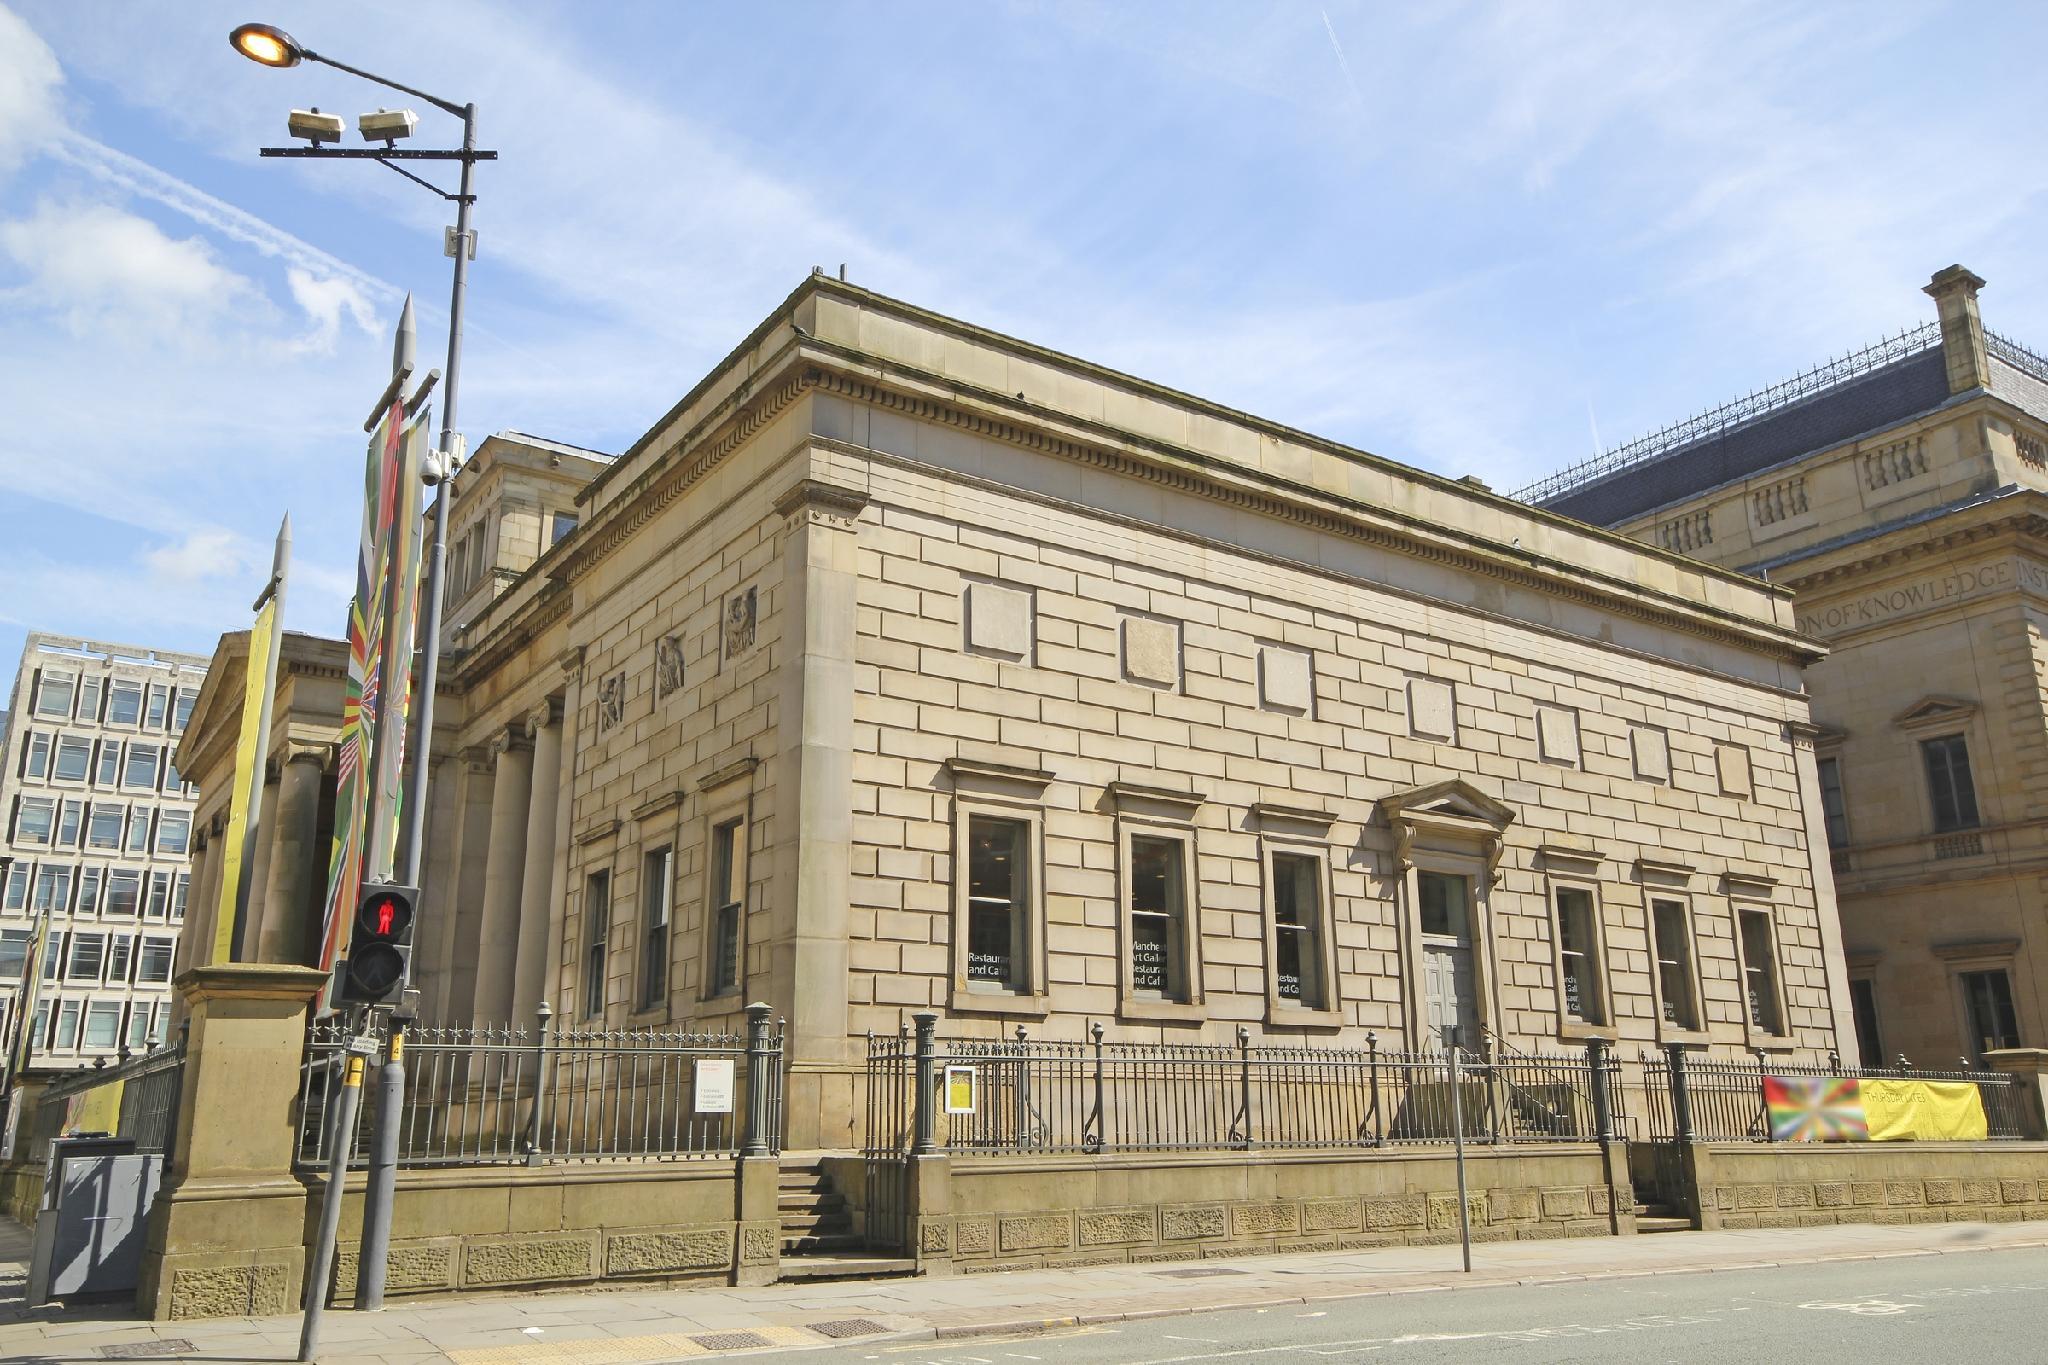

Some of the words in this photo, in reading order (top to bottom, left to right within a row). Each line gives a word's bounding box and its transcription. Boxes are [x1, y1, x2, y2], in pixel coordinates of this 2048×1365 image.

[1857, 562, 2010, 620] KNOWLEDGE
[968, 965, 986, 974] and
[1147, 975, 1161, 985] Caf
[1865, 1092, 1904, 1103] THURSDAY
[1906, 1092, 1926, 1103] LATES
